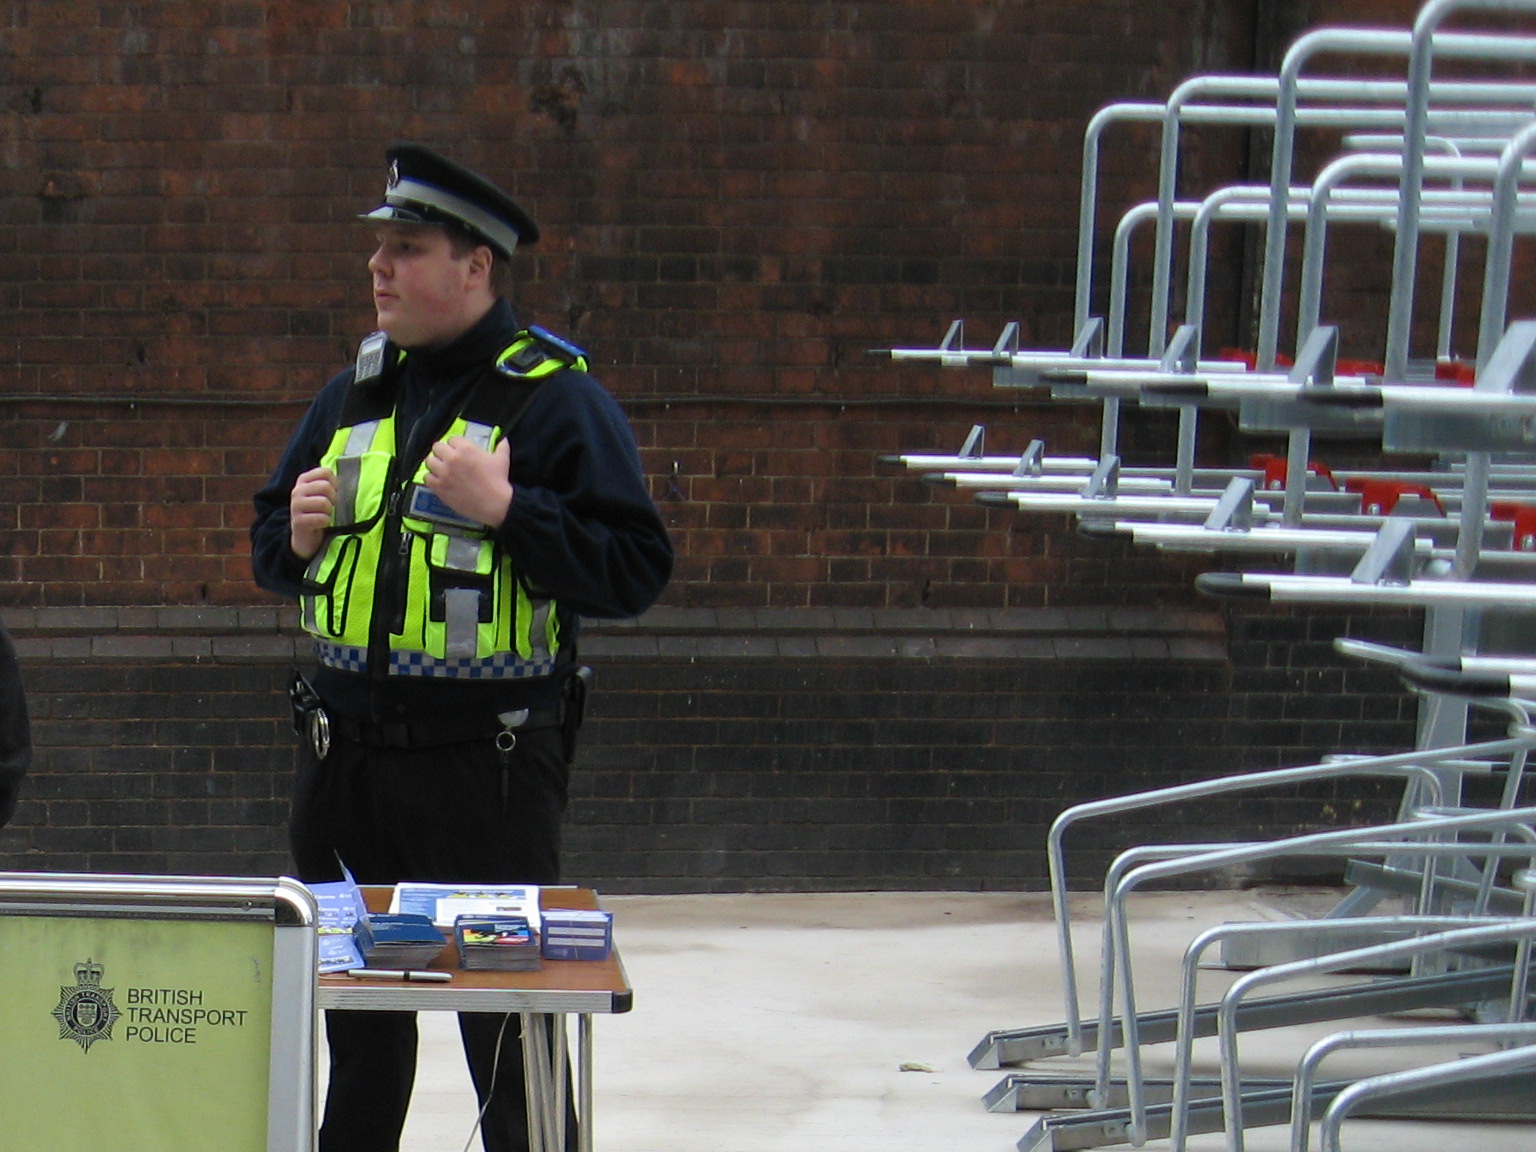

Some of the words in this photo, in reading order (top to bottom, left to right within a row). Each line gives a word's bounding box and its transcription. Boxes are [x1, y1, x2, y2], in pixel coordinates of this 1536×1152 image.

[128, 988, 202, 1005] BRITISH
[127, 1008, 248, 1025] TRANSPORT
[126, 1026, 196, 1043] POLICE
